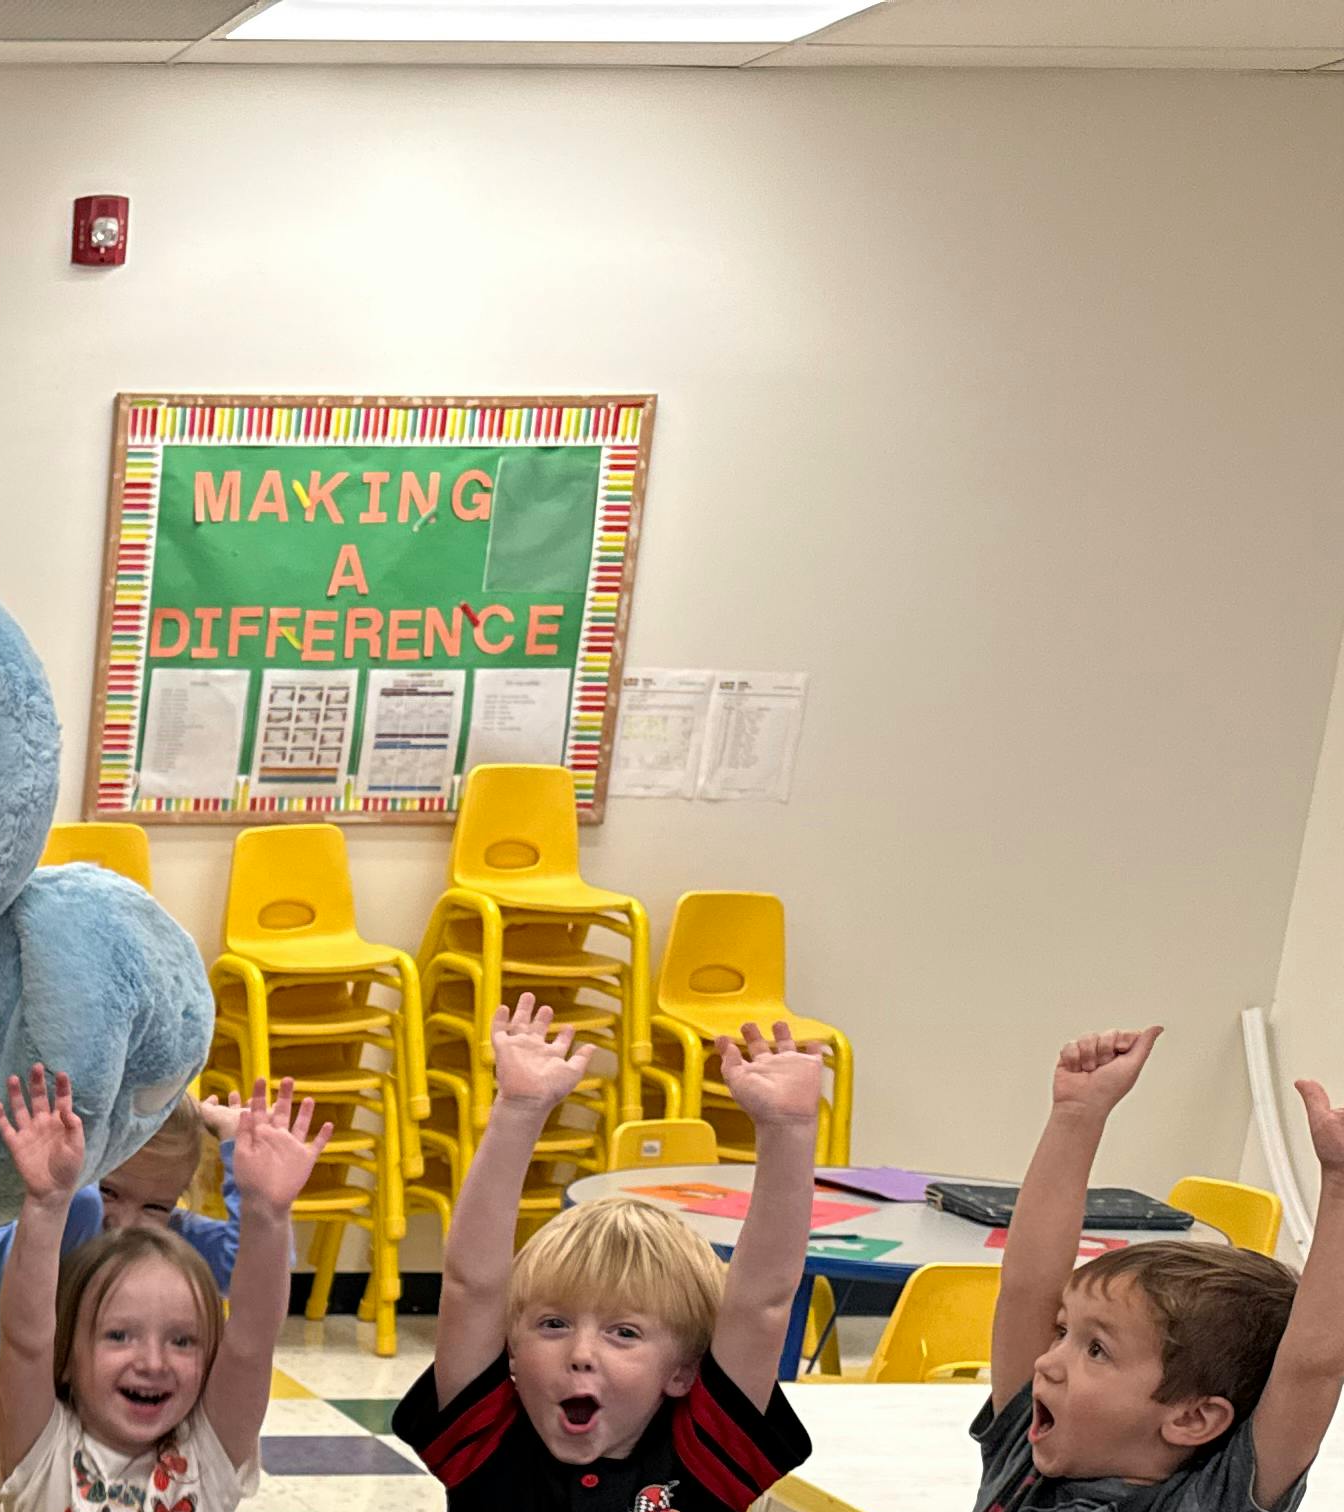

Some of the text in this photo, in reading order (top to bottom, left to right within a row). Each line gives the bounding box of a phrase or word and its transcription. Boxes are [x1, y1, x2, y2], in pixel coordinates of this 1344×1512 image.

[193, 469, 494, 524] MAKING
[327, 544, 370, 597] A
[149, 604, 566, 662] DIFFERENCE
